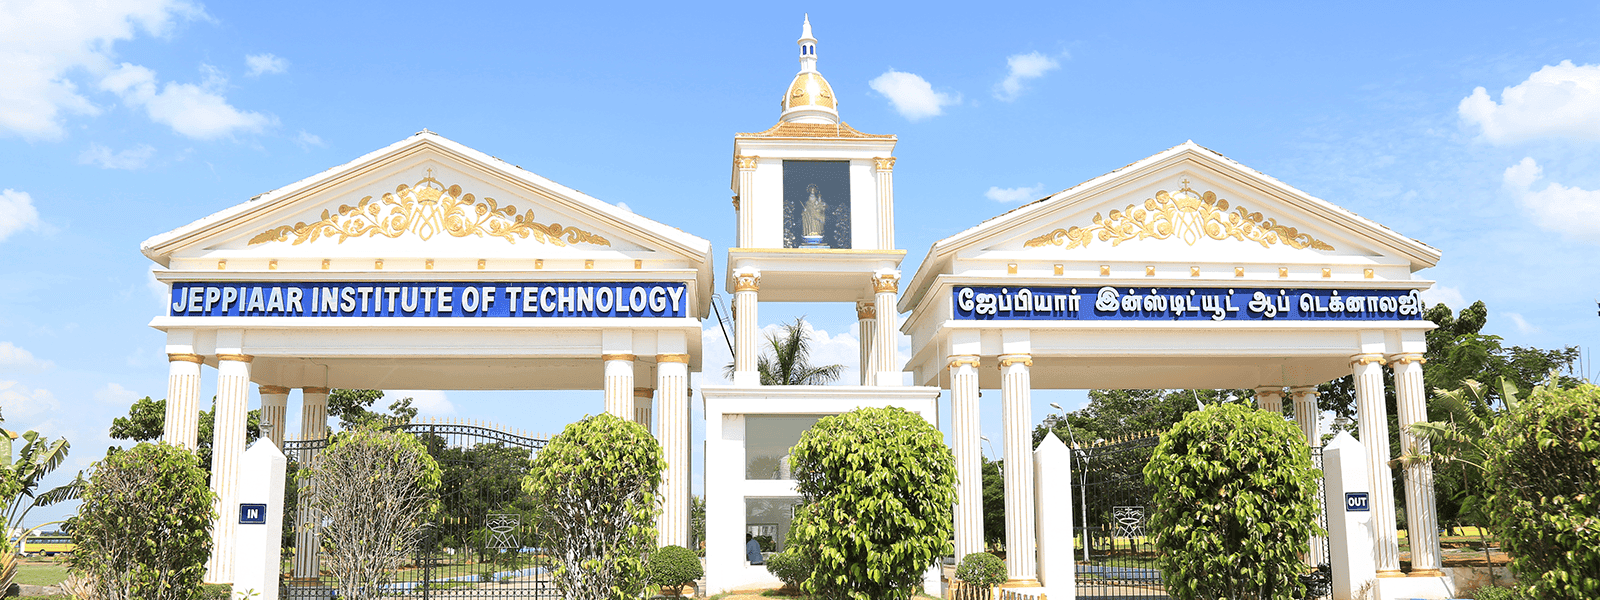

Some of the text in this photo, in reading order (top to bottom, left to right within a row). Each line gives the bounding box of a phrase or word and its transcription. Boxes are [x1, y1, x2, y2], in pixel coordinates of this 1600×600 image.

[172, 286, 685, 313] JEPPIAAR INSTITUTE OF TECHNOLOGY
[958, 286, 1422, 321] ஜேப்பியார் இன்ஸ்டிட்யூட் ஆப் டெக்னாலஜி
[1348, 497, 1367, 507] OUT
[247, 508, 259, 519] IN
